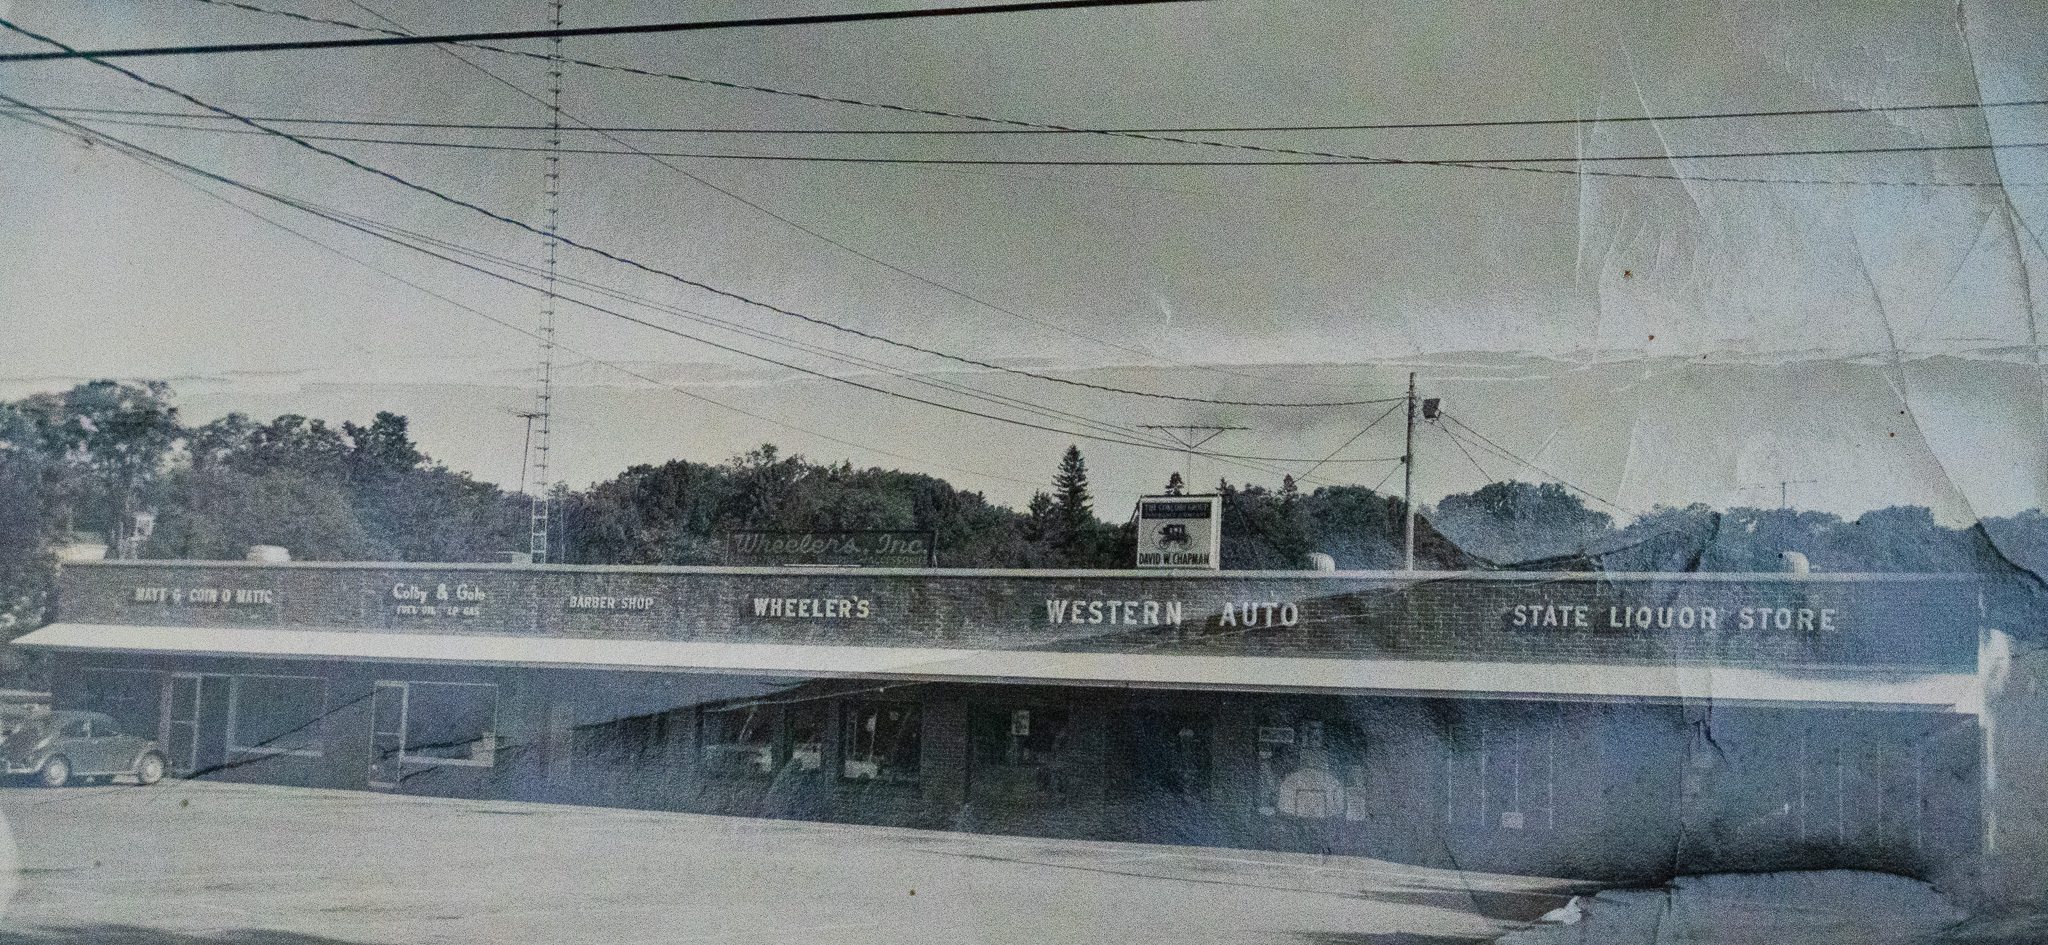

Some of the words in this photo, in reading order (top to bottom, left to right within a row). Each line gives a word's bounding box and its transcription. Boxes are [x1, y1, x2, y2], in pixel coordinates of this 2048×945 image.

[1139, 552, 1161, 565] DAVID
[1172, 552, 1210, 565] CHAPMAN
[189, 588, 218, 603] COIN
[221, 589, 232, 602] O
[236, 589, 273, 603] MATIC
[392, 582, 428, 604] Colby
[436, 582, 449, 600] &
[569, 595, 616, 609] BARBER
[621, 597, 654, 610] SHOP
[753, 595, 870, 619] WHEELER'S
[1046, 599, 1182, 626] WESTERN
[1219, 601, 1299, 627] AUTO
[1512, 604, 1589, 627] STATE
[1609, 605, 1717, 629] LIQUOR
[1738, 606, 1837, 632] STORE
